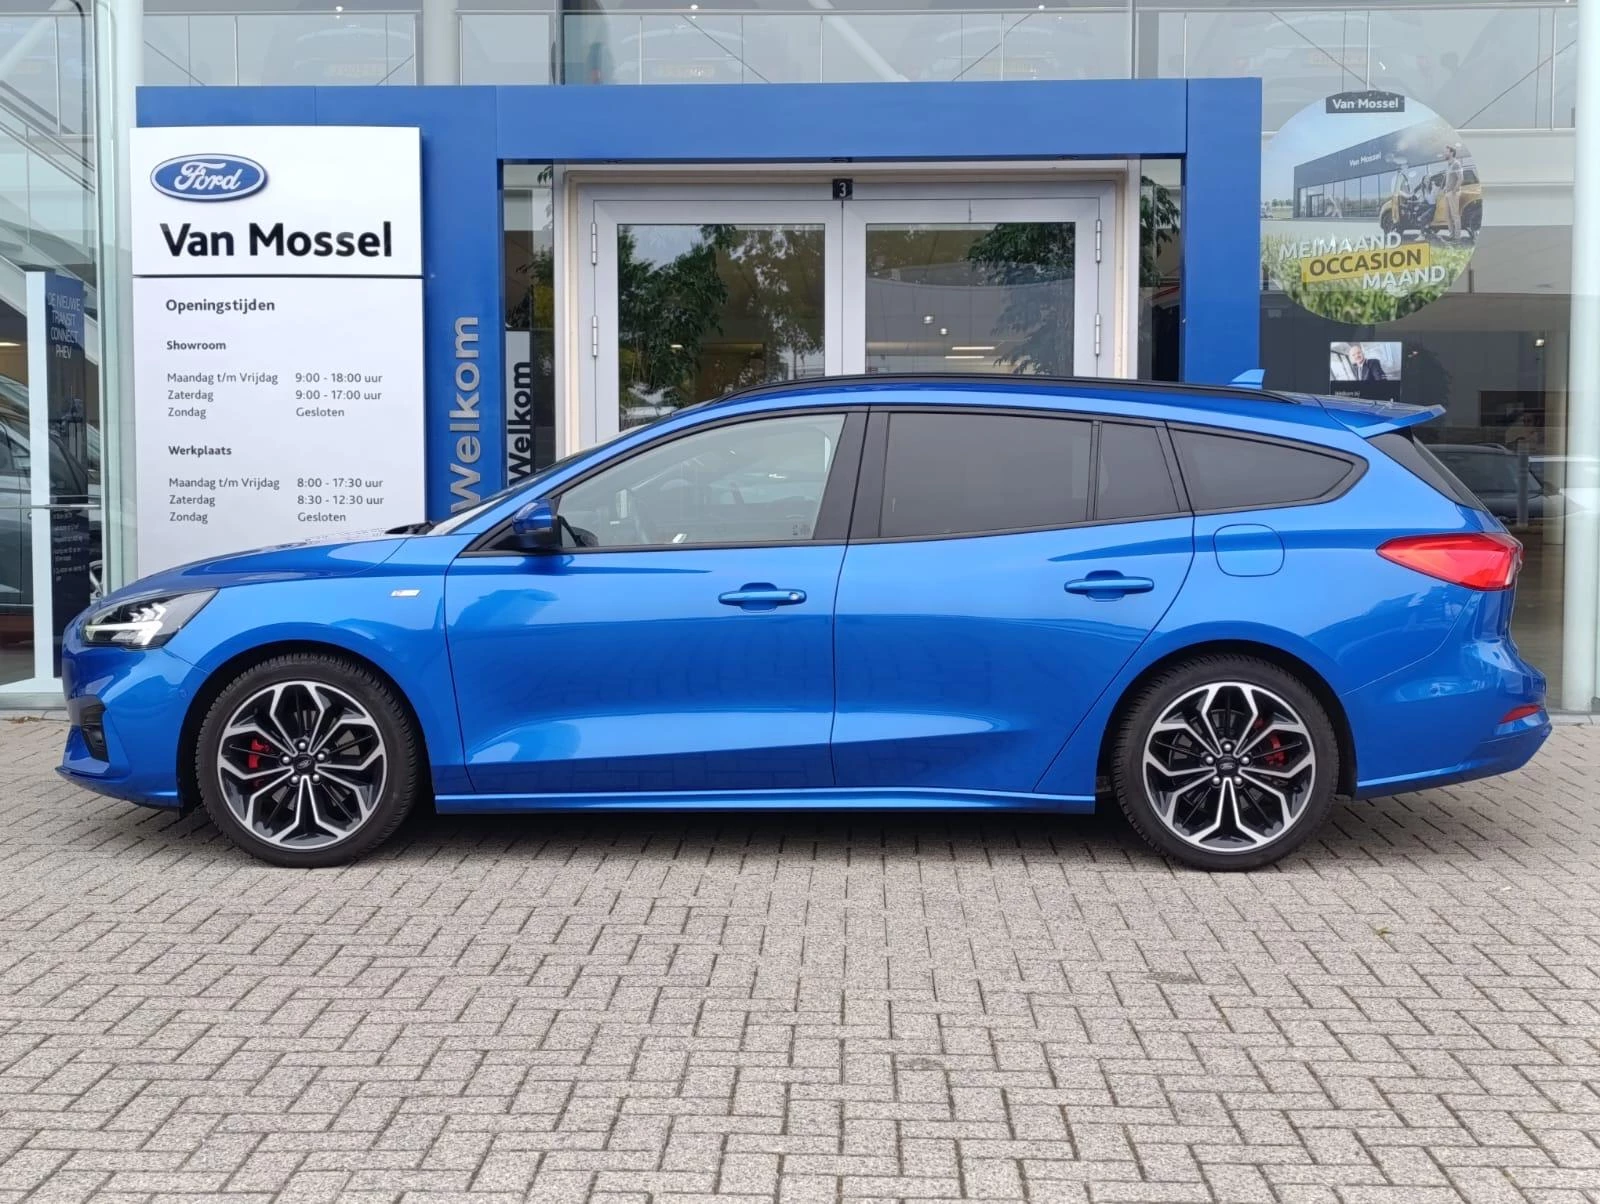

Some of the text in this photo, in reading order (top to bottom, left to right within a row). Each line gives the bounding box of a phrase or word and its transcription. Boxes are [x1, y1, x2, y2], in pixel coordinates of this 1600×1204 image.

[1332, 97, 1399, 109] Van Mossel
[1349, 152, 1382, 167] Van Mossel
[174, 161, 243, 191] Ford
[839, 182, 847, 197] 3
[160, 221, 392, 258] Van Mossel
[1279, 231, 1402, 260] MEIMAAND
[1309, 249, 1422, 277] OCCASION
[1363, 265, 1446, 289] MAAND
[165, 297, 276, 315] Openingstijden
[56, 344, 72, 359] PHEV
[166, 339, 227, 351] Showroom
[167, 372, 215, 386] Maandag
[216, 372, 237, 383] t/m
[239, 371, 279, 386] Vrijdag
[295, 372, 321, 383] 9:00
[331, 372, 362, 383] 18:00
[364, 375, 383, 383] uur
[167, 389, 214, 403] Zaterdag
[295, 389, 321, 400] 9:00
[331, 389, 361, 400] 17:00
[363, 392, 382, 400] uur
[167, 406, 345, 420] Zondag Gesloten
[449, 315, 481, 513] Welkom
[507, 361, 532, 485] Welkom
[168, 444, 232, 458] Werkplaats
[168, 477, 216, 491] Maandag
[218, 477, 239, 488] t/m
[241, 477, 280, 491] Vrijdag
[296, 477, 322, 488] 8:00
[332, 477, 362, 488] 17:30
[365, 480, 384, 488] uur
[169, 494, 215, 508] Zaterdag
[297, 494, 322, 505] 8:30
[333, 494, 363, 505] 12:30
[366, 497, 385, 505] uur
[169, 511, 347, 525] Zondag Gesloten
